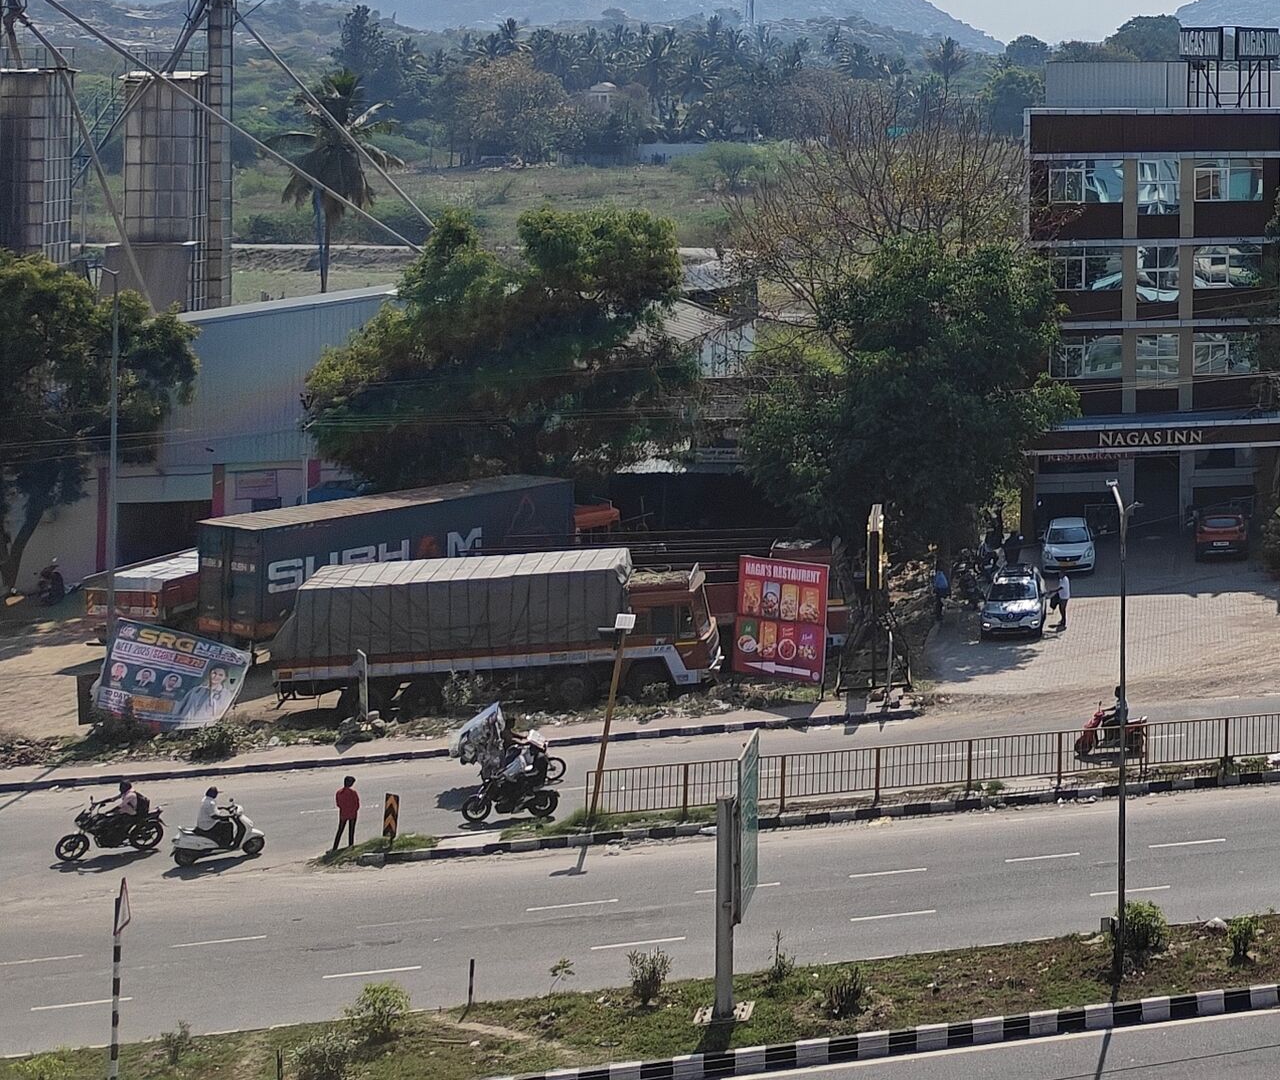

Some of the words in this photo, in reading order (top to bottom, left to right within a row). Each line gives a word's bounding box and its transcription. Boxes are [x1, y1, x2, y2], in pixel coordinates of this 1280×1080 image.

[1098, 431, 1162, 447] NAGAS
[1166, 429, 1204, 445] INN
[744, 561, 773, 578] NAGA'S
[772, 565, 822, 584] RESTAURANT
[137, 628, 196, 653] SRG
